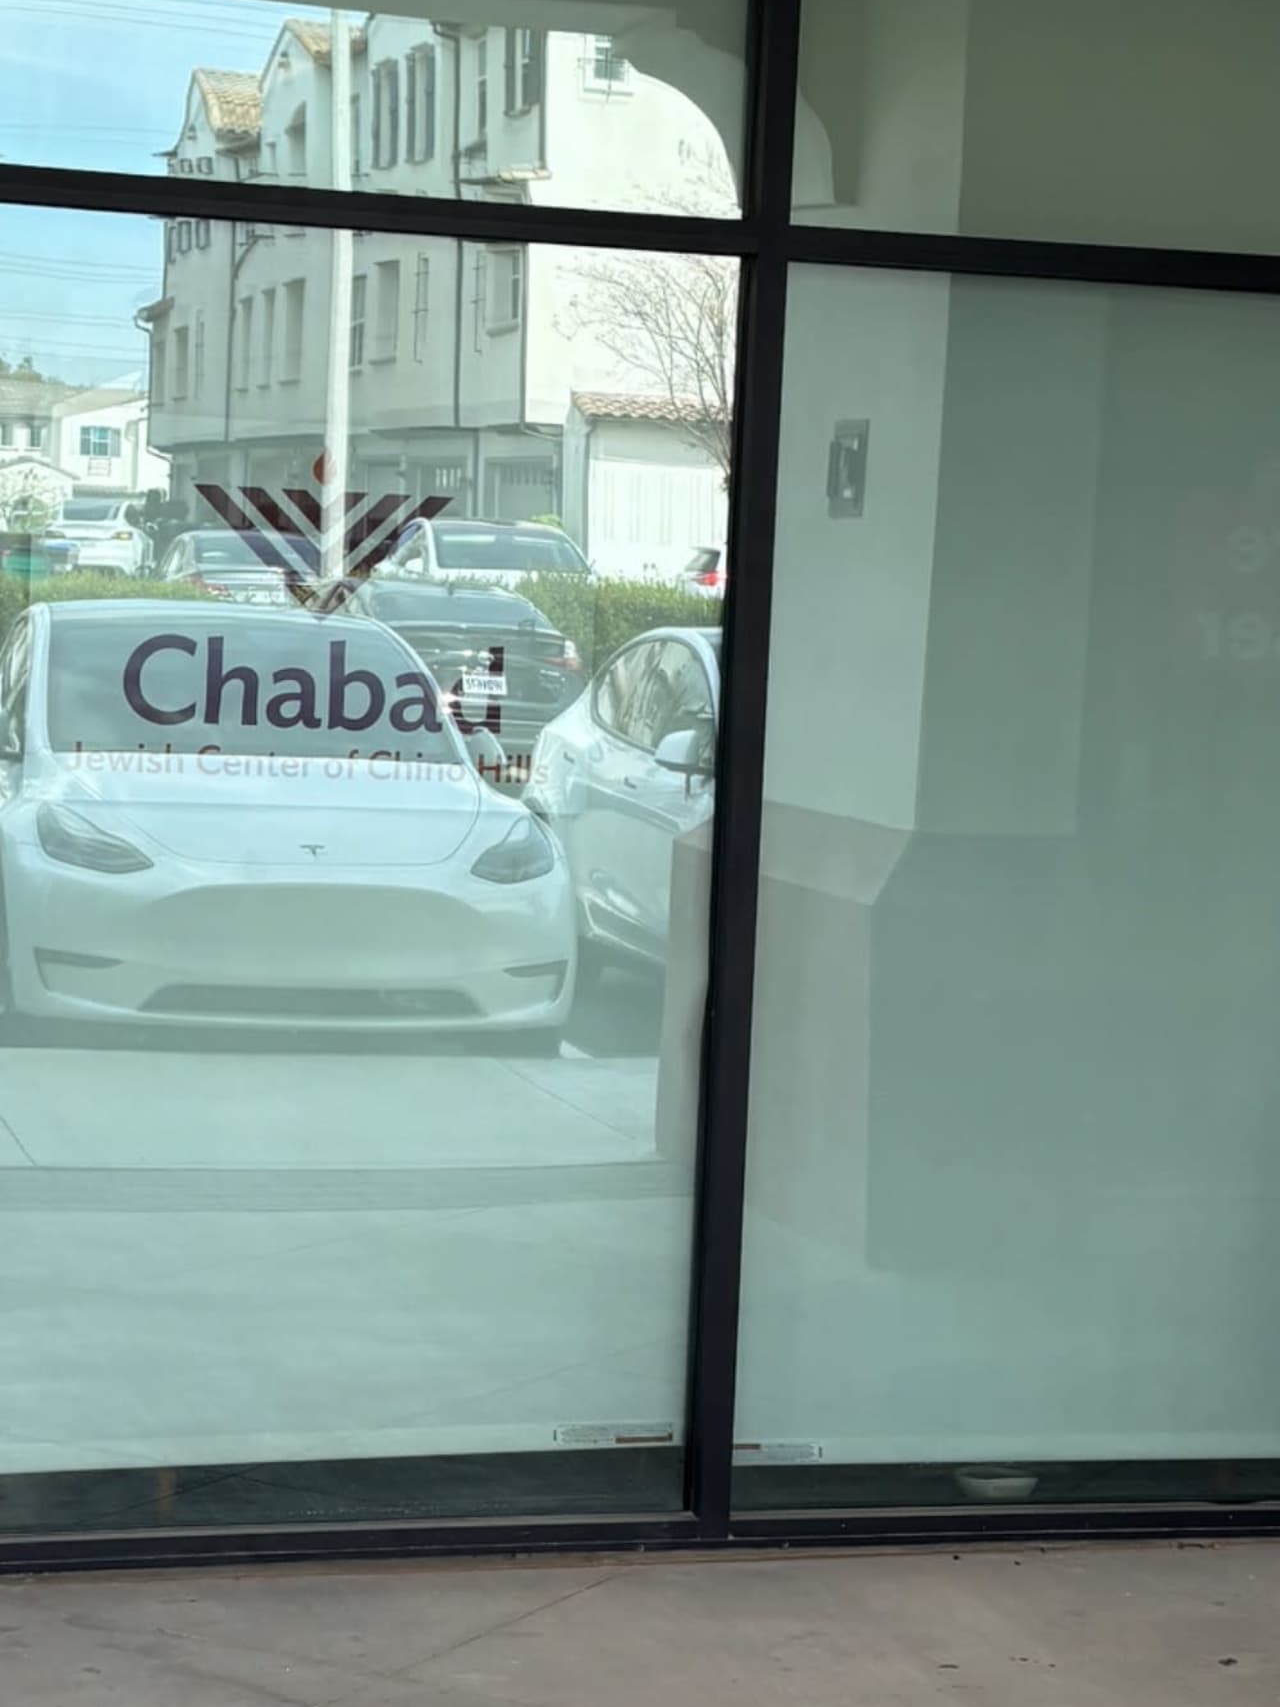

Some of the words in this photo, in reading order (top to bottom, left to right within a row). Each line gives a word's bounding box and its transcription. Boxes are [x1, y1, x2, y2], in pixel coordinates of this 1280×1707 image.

[123, 633, 505, 734] Chabad
[66, 741, 184, 776] Jewish
[197, 744, 316, 779] Center
[323, 749, 363, 780] of
[368, 750, 467, 783] Chino
[478, 753, 550, 786] Hills
